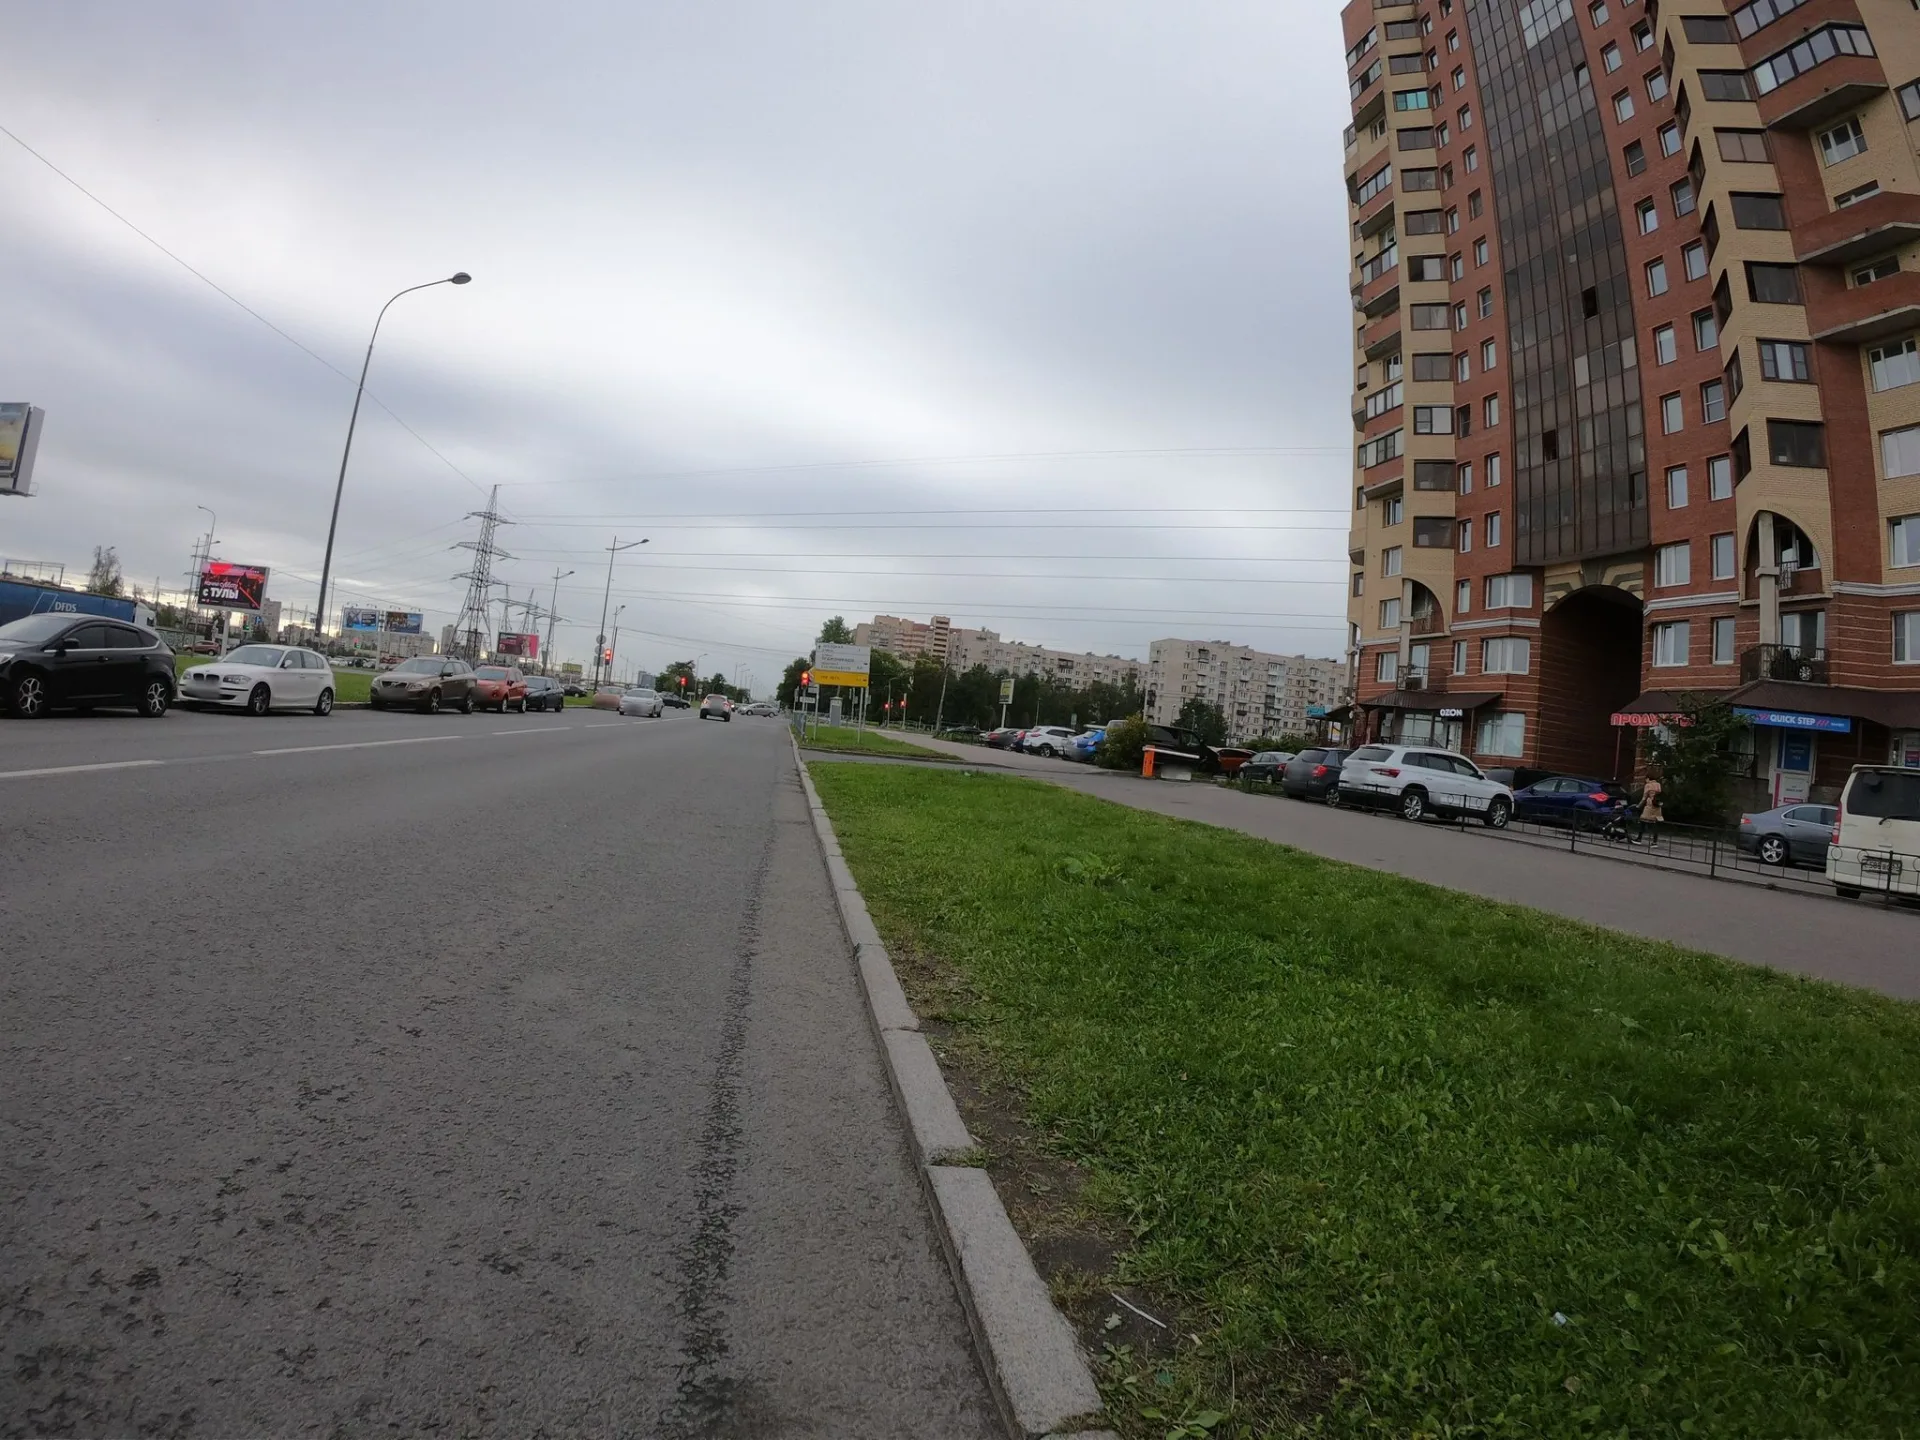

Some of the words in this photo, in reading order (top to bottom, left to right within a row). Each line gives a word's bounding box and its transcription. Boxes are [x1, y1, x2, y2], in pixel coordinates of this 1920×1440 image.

[210, 587, 239, 599] ТУЛЫ
[54, 601, 77, 612] DFDS
[1440, 708, 1463, 717] OZON
[1769, 714, 1796, 724] QUICK
[1797, 716, 1816, 726] STEP
